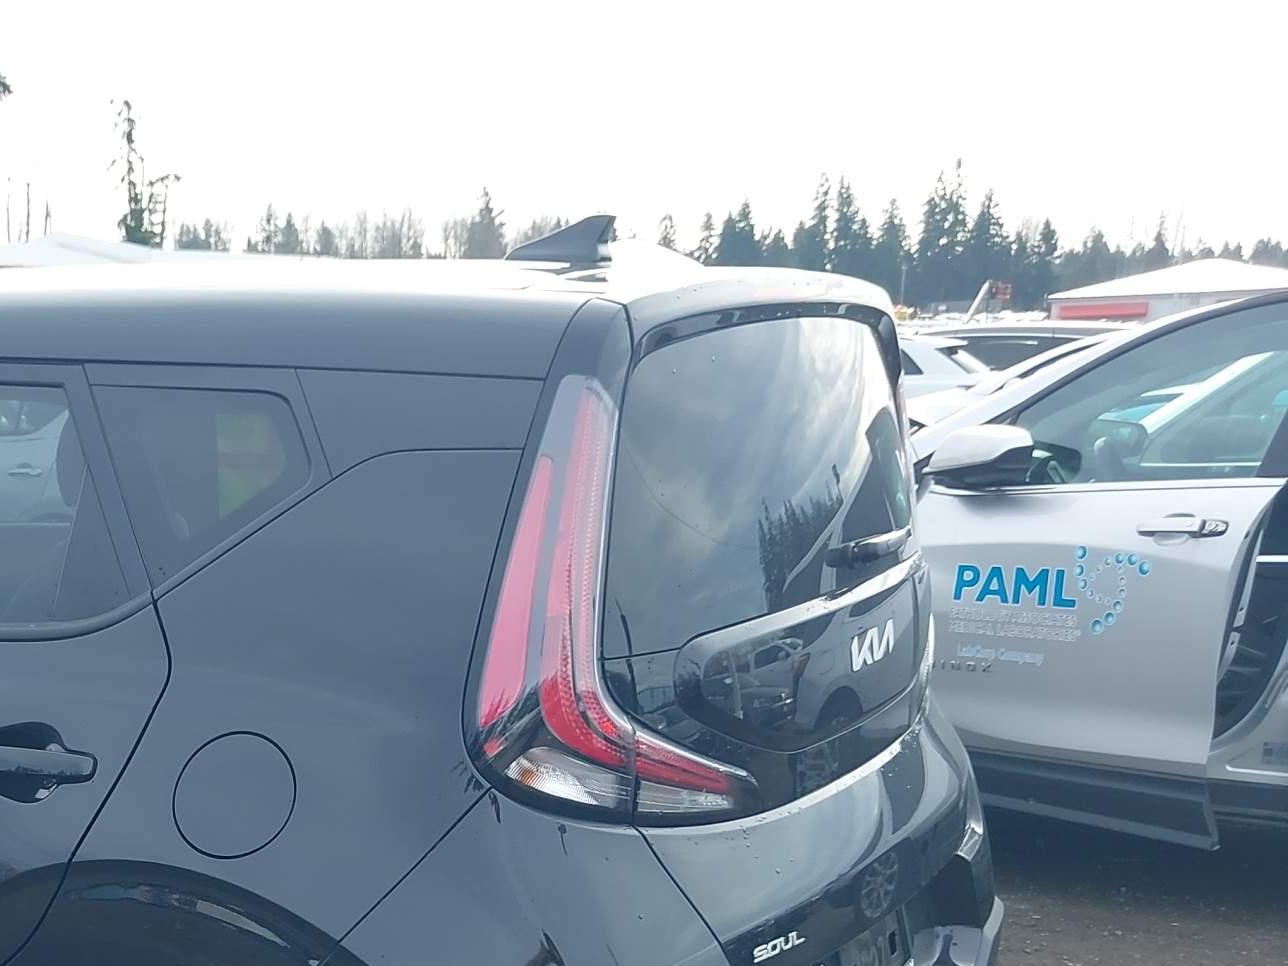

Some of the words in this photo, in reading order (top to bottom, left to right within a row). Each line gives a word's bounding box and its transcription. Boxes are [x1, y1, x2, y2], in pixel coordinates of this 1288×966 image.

[951, 563, 1077, 609] PAML
[851, 618, 894, 672] KIA
[753, 931, 807, 963] SOUL
